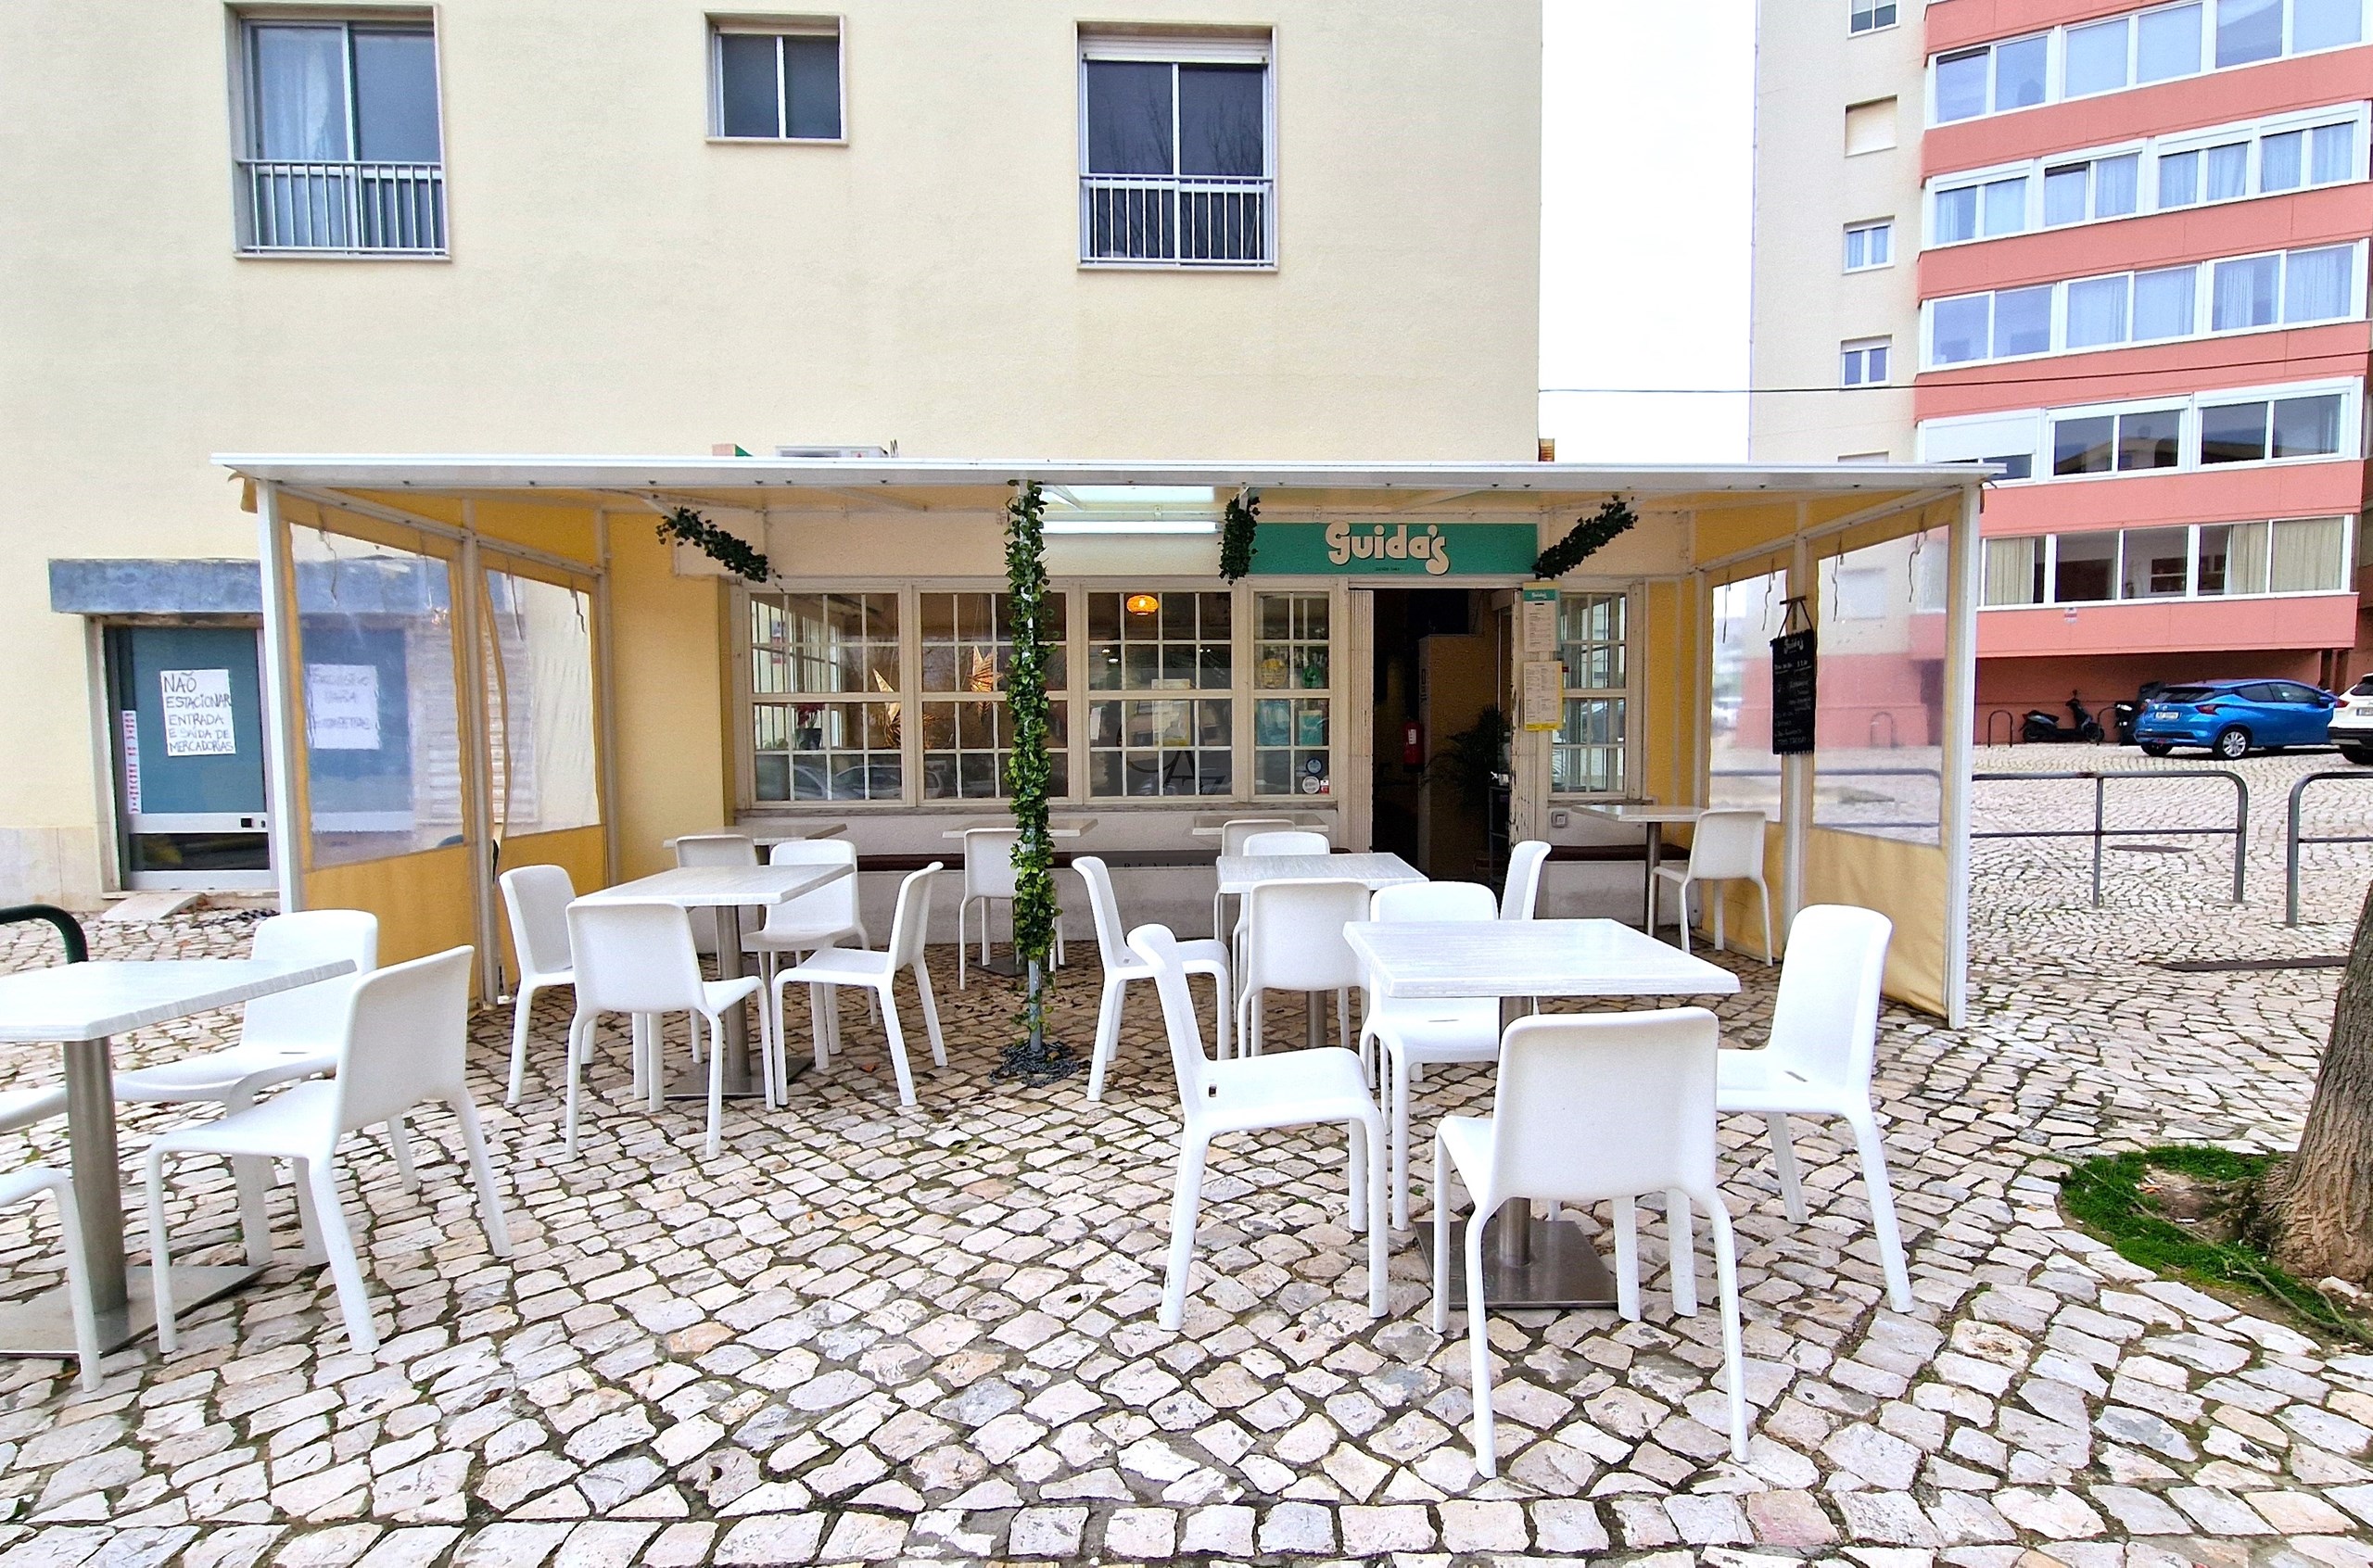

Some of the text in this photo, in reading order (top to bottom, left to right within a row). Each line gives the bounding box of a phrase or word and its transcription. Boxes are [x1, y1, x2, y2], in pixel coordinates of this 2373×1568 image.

[164, 671, 197, 693] NÃO
[166, 693, 232, 709] ESTACIONAR
[169, 713, 224, 726] ENTRADA
[169, 728, 177, 739] E
[215, 729, 229, 739] DE
[169, 740, 234, 752] MERCADORIAS
